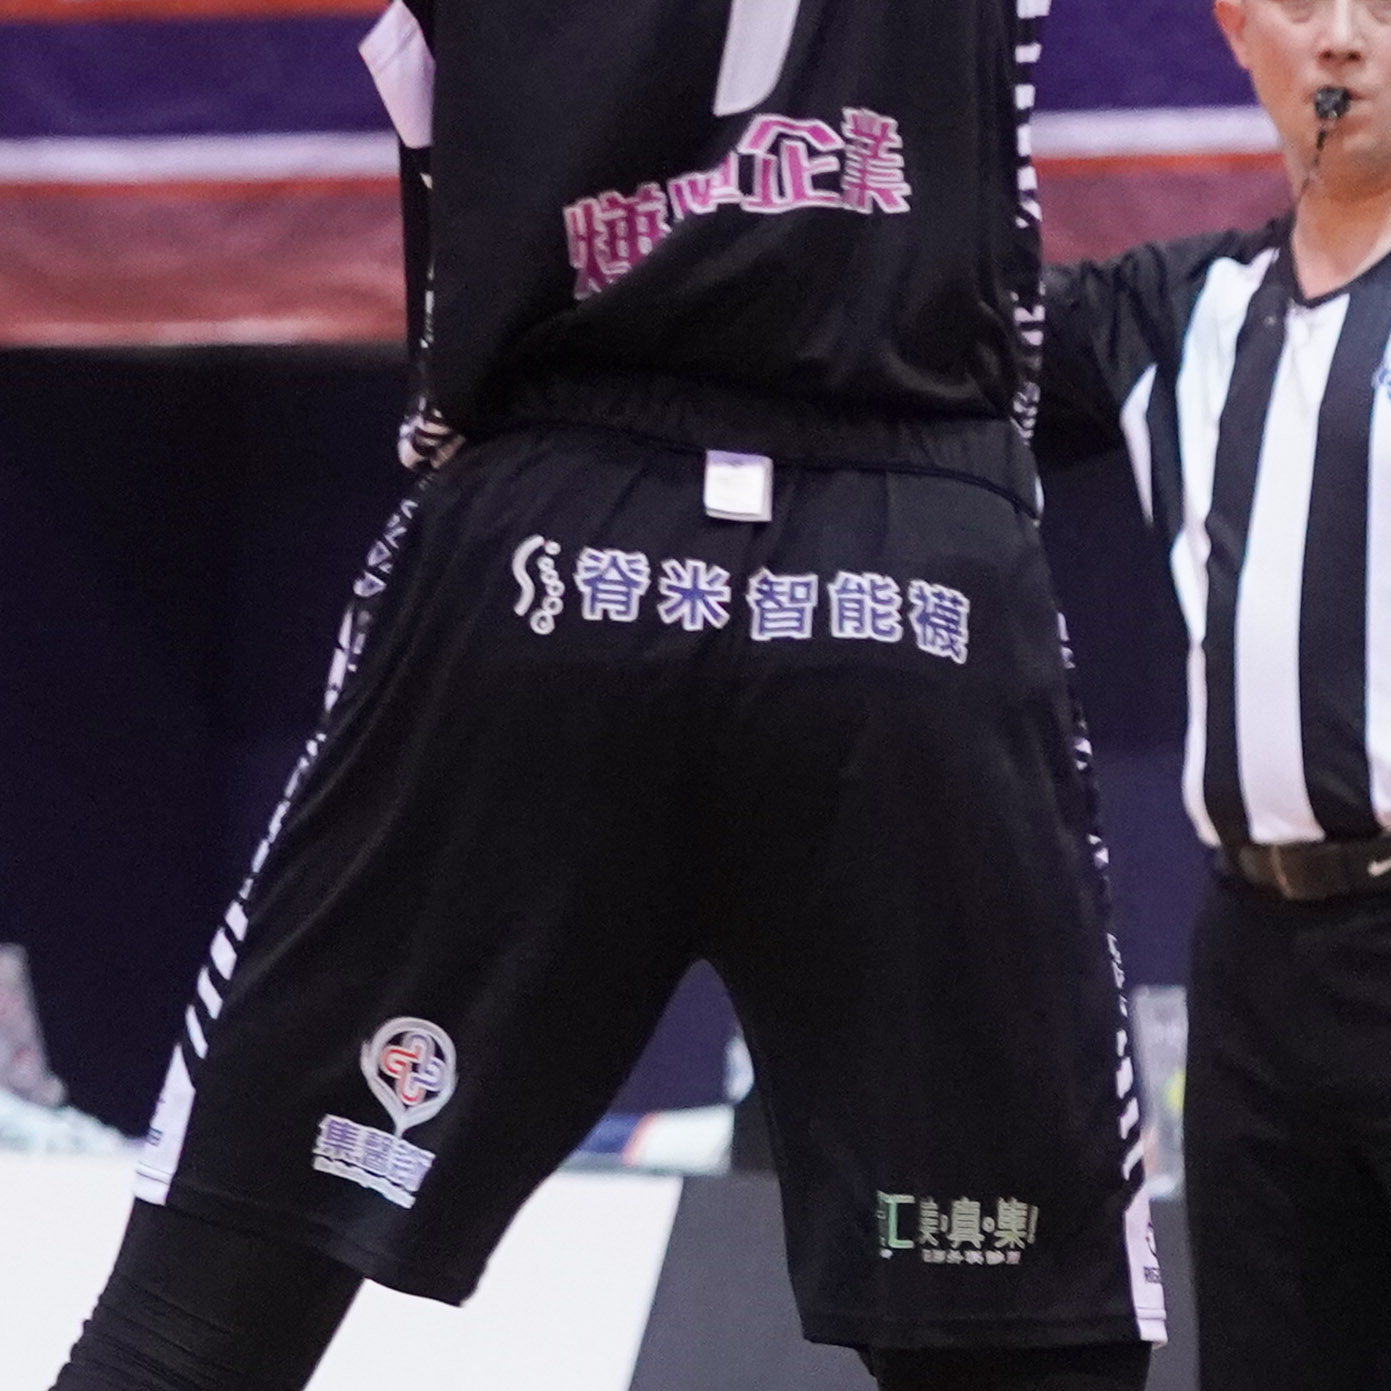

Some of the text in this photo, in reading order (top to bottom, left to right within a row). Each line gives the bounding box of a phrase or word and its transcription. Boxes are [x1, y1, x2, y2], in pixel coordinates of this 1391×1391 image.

[572, 546, 972, 664] 脊米智能襪
